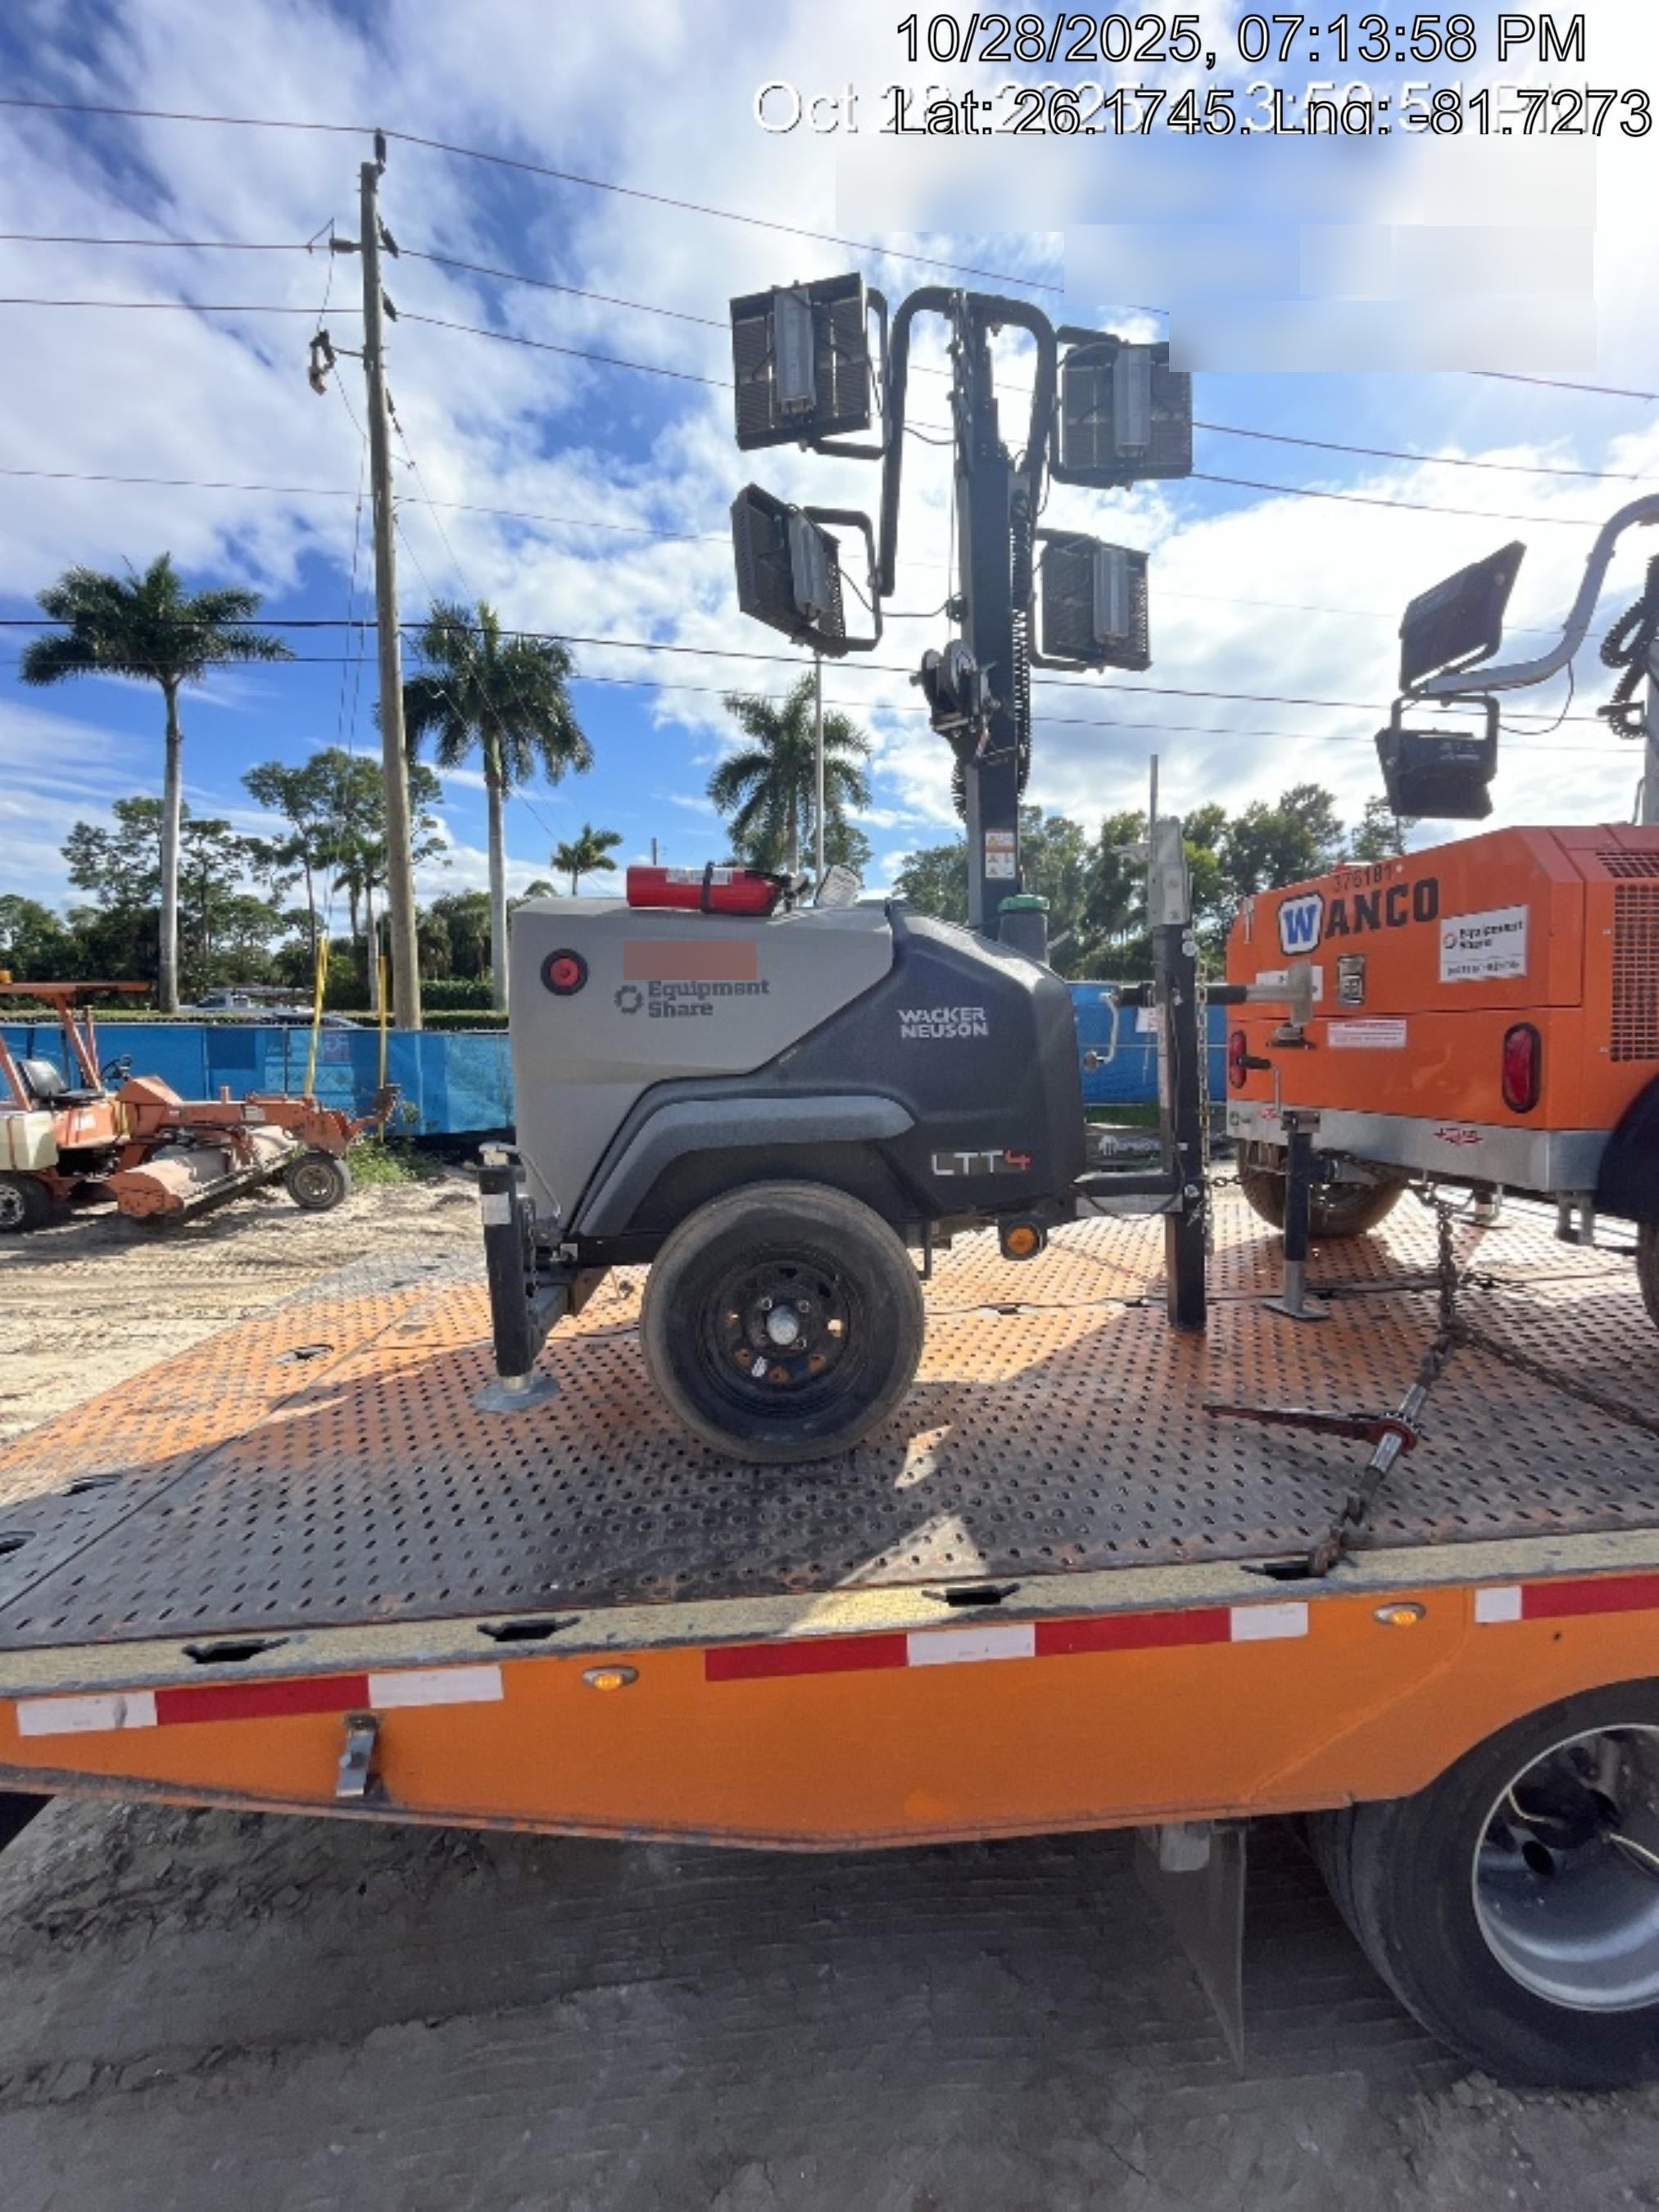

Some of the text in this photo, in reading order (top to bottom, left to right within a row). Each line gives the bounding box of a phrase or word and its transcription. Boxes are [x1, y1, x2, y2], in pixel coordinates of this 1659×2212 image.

[1281, 877, 1439, 946] WANCO
[647, 978, 771, 1001] Equipment
[647, 1000, 714, 1018] Share
[897, 1006, 986, 1023] WACKER
[900, 1022, 990, 1039] NEUSON
[931, 1149, 1031, 1176] LTT4
